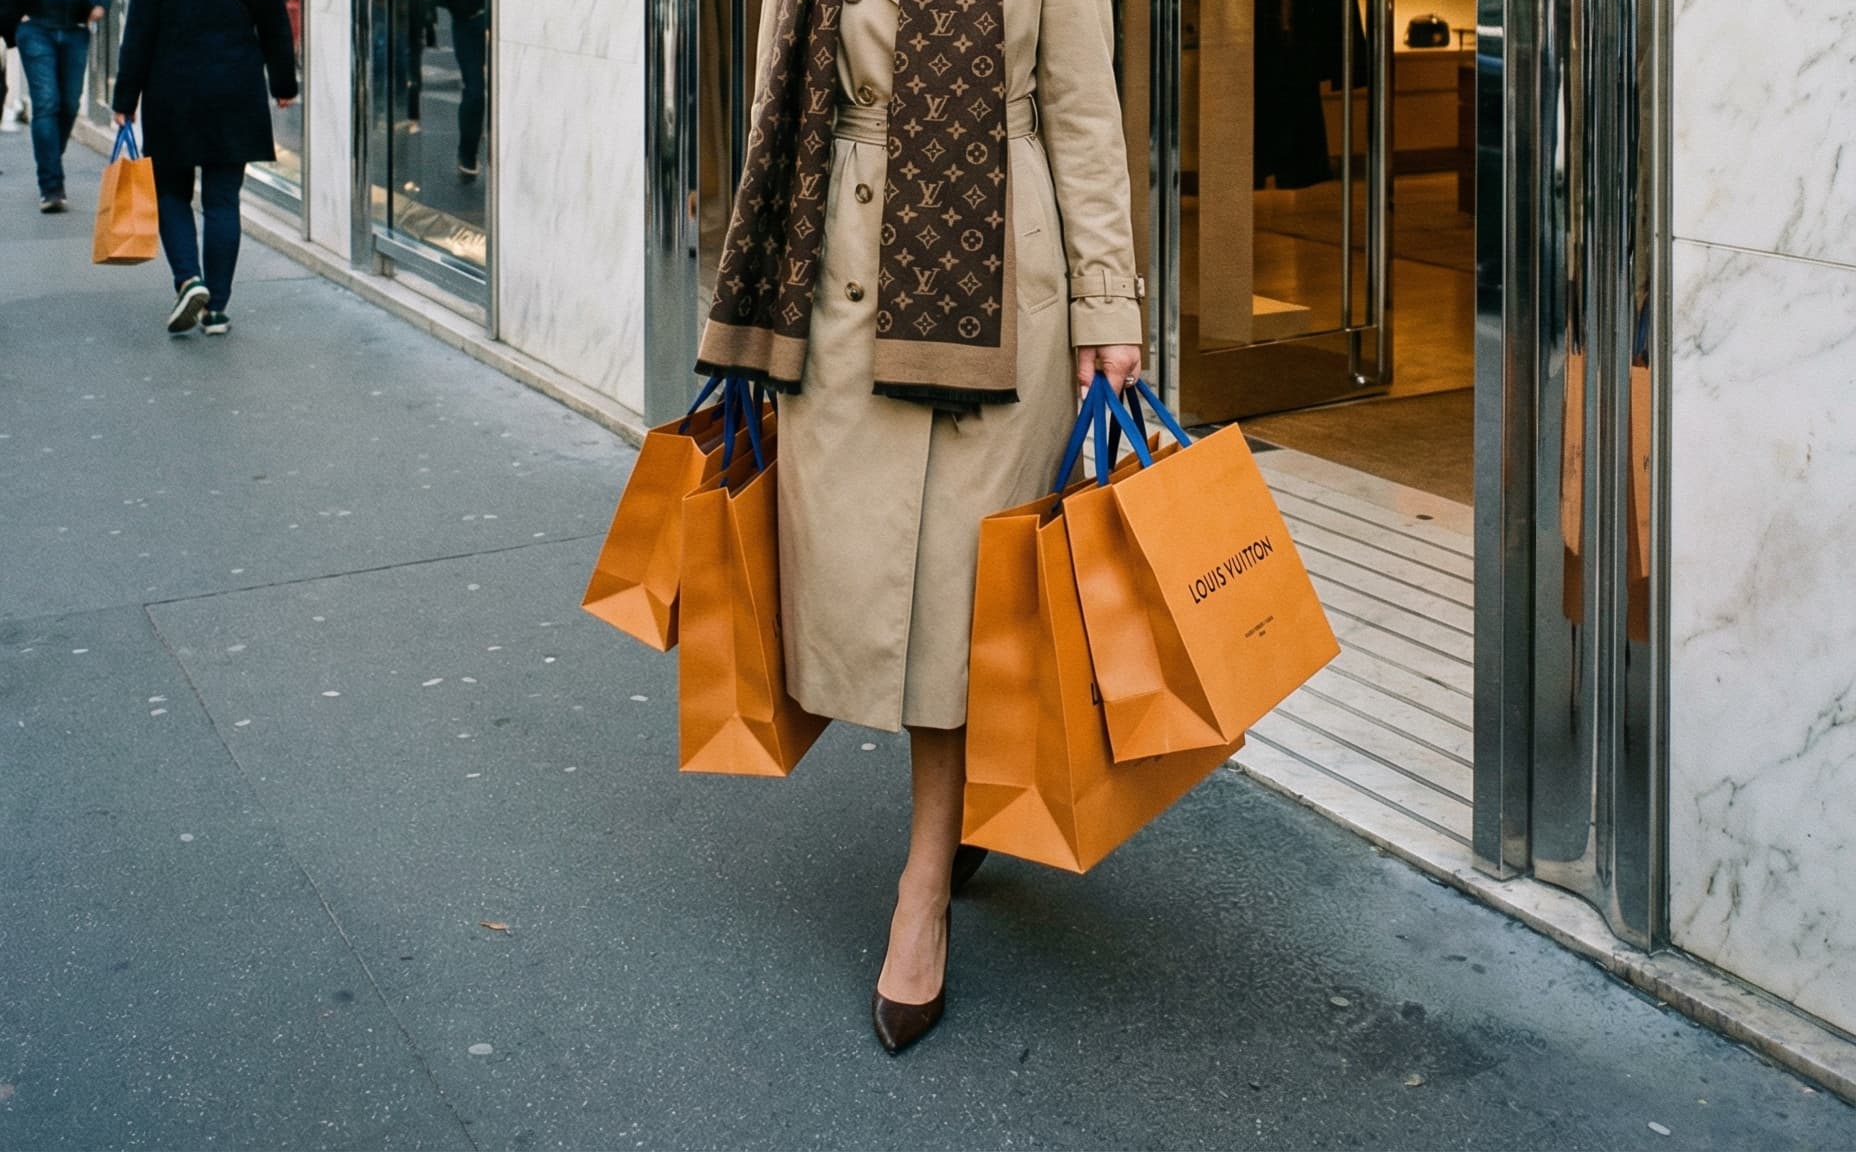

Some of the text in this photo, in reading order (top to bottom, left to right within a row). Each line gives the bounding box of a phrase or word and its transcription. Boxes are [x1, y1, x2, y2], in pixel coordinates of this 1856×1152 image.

[929, 9, 958, 37] LV
[922, 94, 951, 121] LV
[916, 180, 945, 208] LV
[912, 266, 941, 295] LV
[1188, 565, 1227, 605] LOUIS
